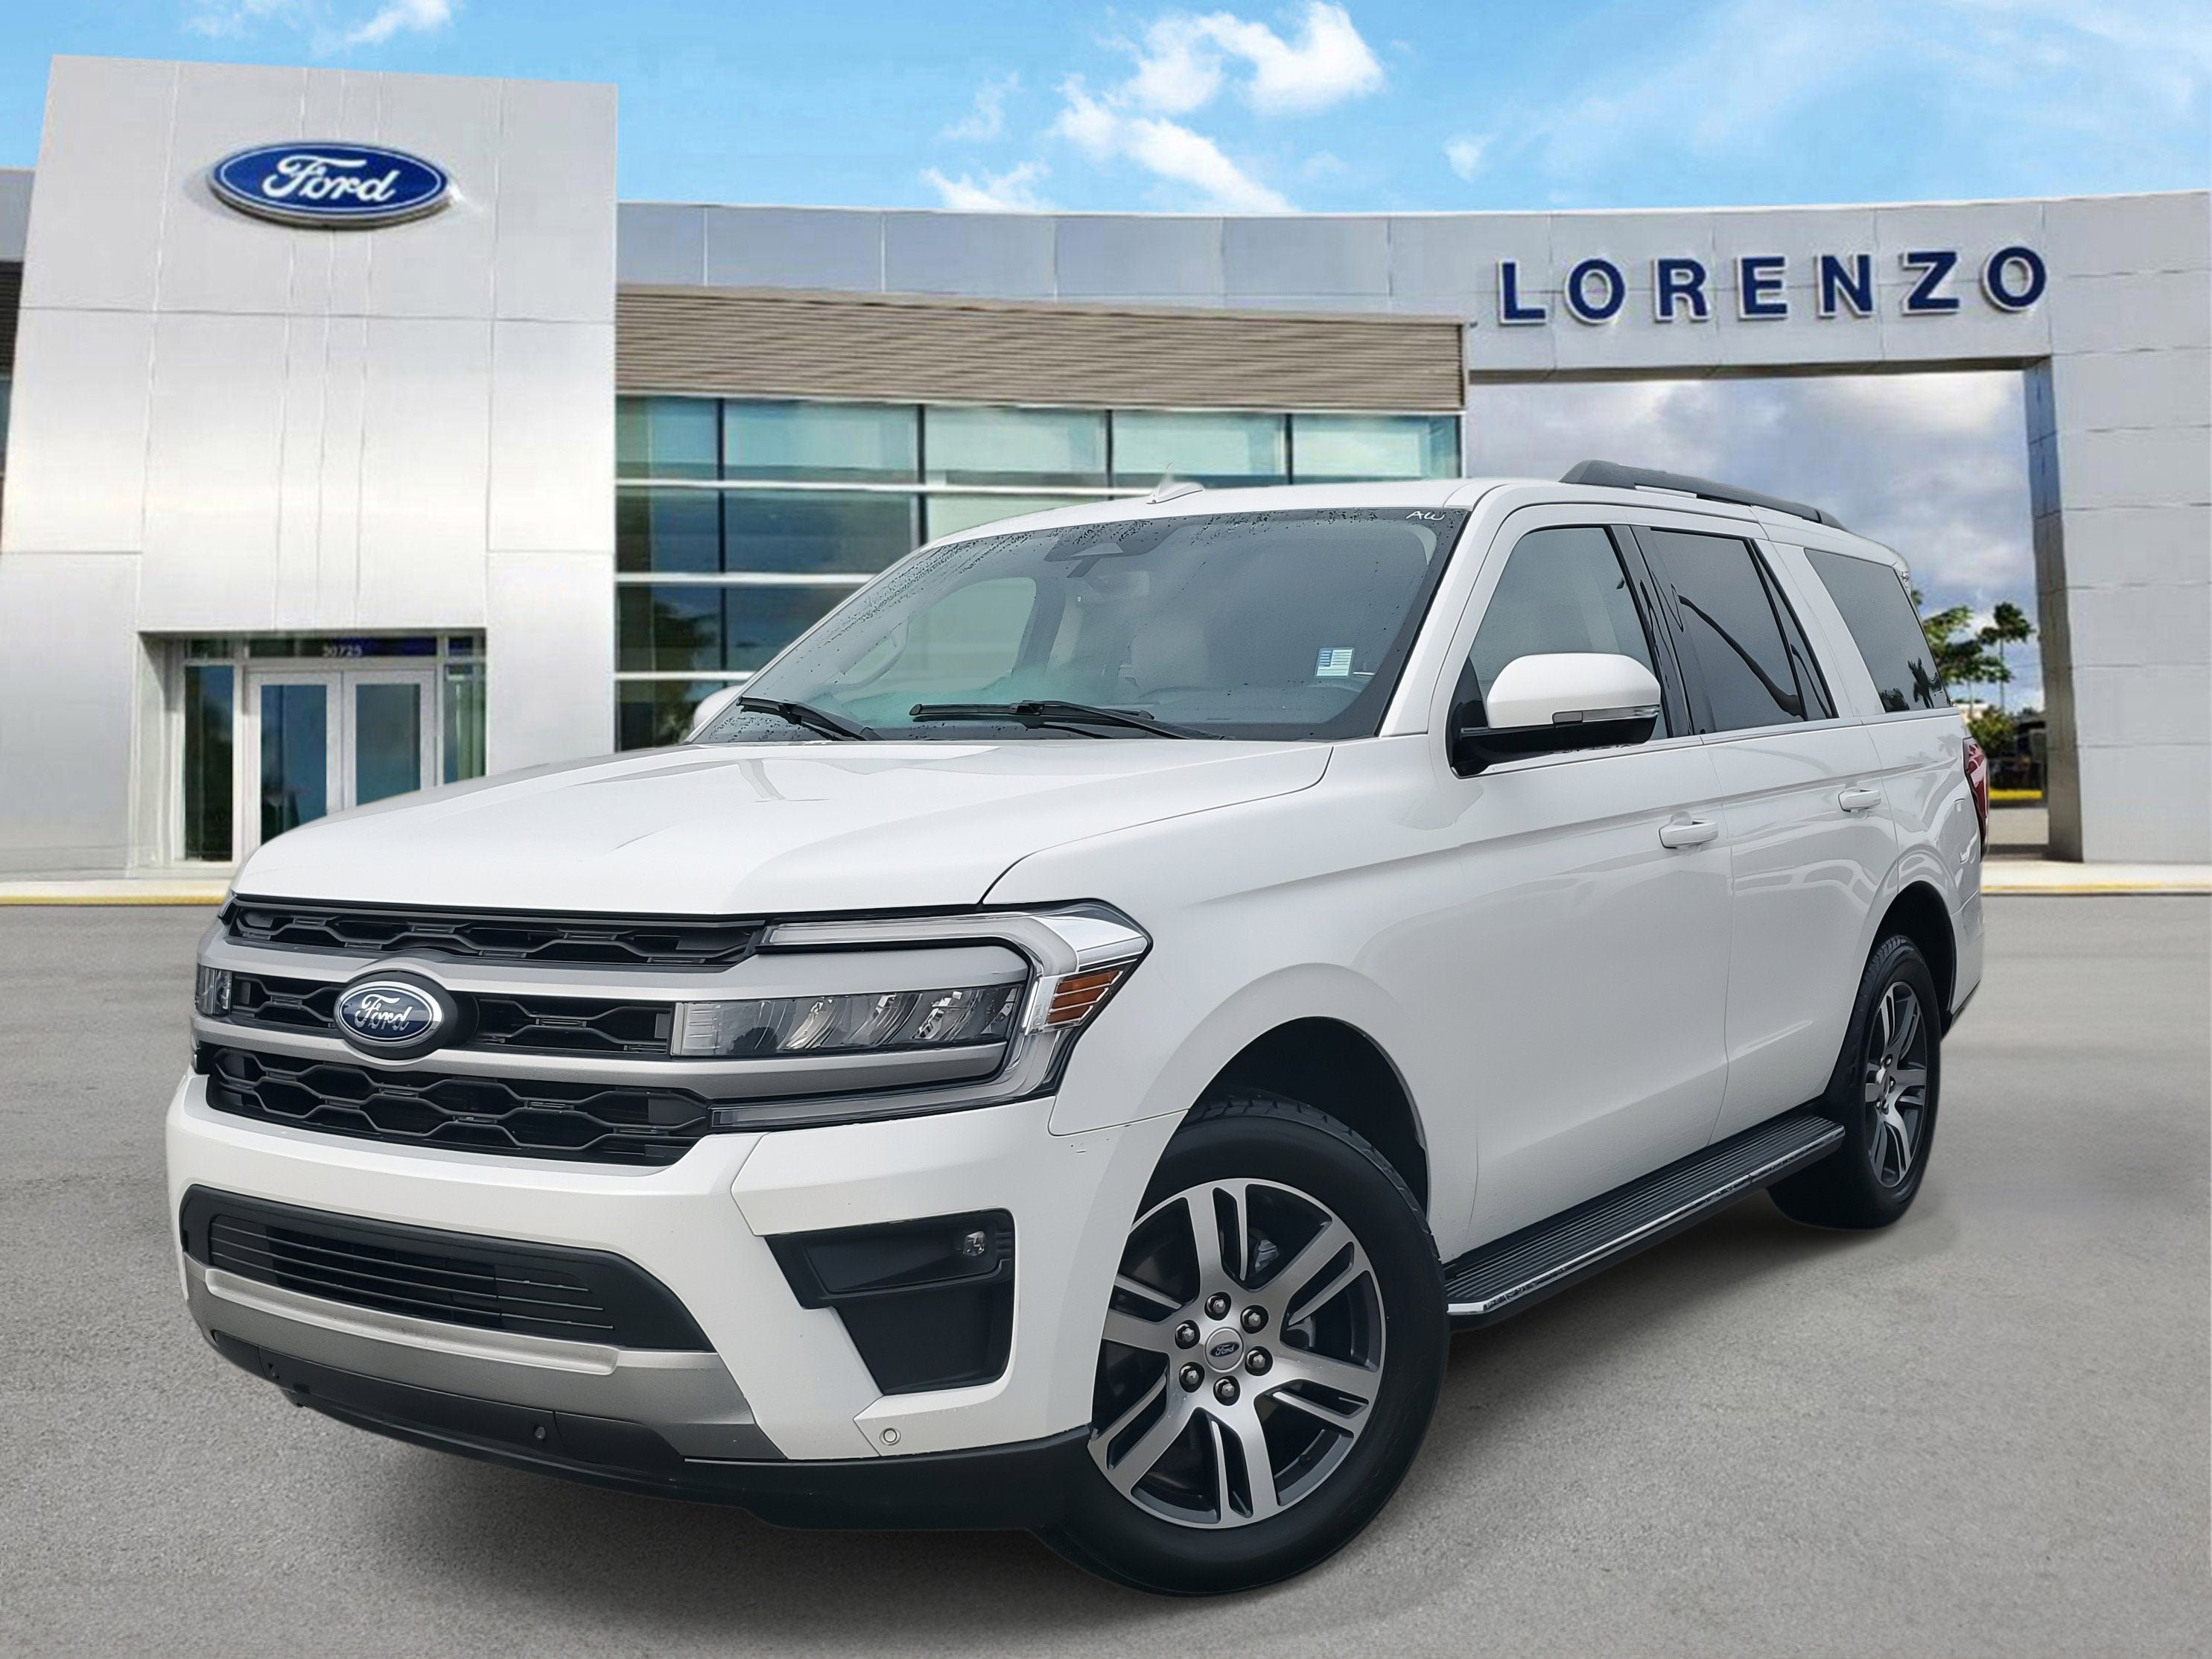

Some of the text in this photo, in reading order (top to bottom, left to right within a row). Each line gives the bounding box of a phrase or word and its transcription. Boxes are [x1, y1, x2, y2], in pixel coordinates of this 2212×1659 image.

[261, 153, 401, 202] Ford
[1498, 247, 2047, 326] LORENZO
[354, 993, 413, 1032] Ford
[1215, 1343, 1236, 1356] Ford
